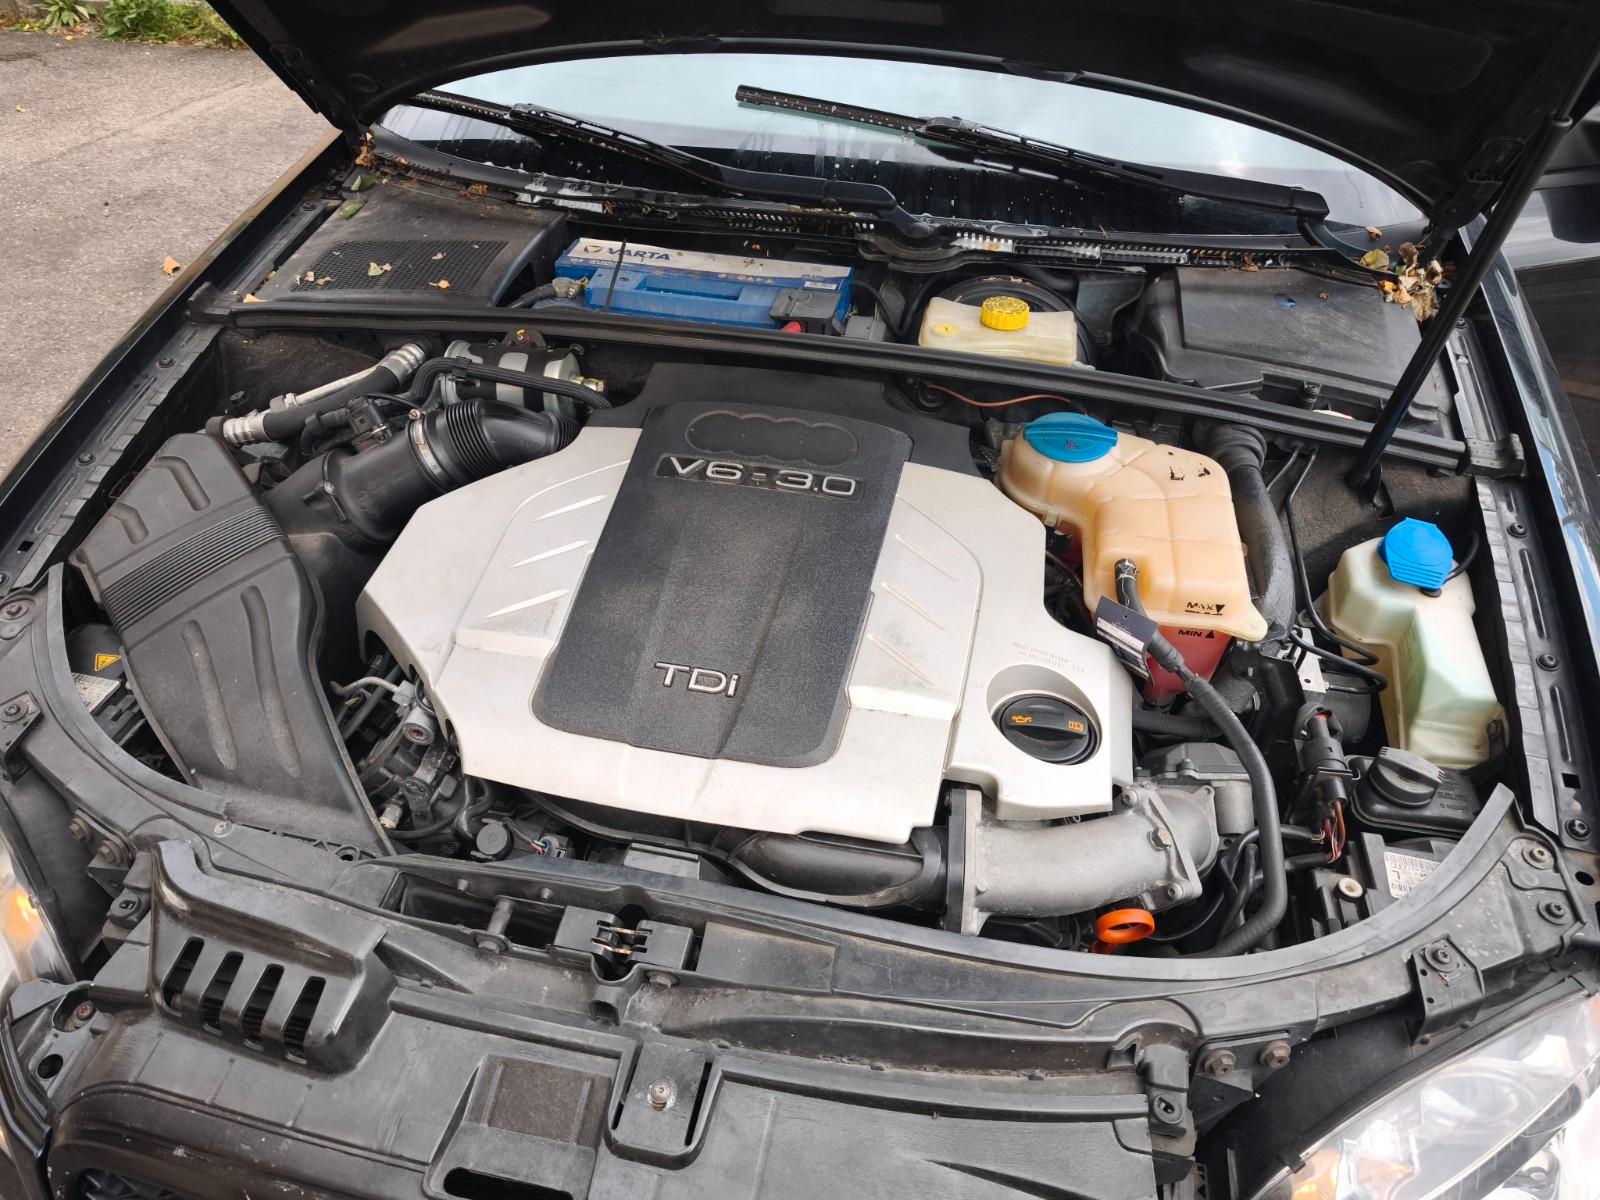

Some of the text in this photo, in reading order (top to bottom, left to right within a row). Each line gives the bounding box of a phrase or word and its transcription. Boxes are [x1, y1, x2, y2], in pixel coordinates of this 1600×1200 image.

[608, 246, 671, 261] VARTA
[670, 456, 744, 480] V6
[775, 469, 857, 496] 3.0
[1185, 601, 1214, 611] MAX
[1178, 629, 1203, 638] MIN
